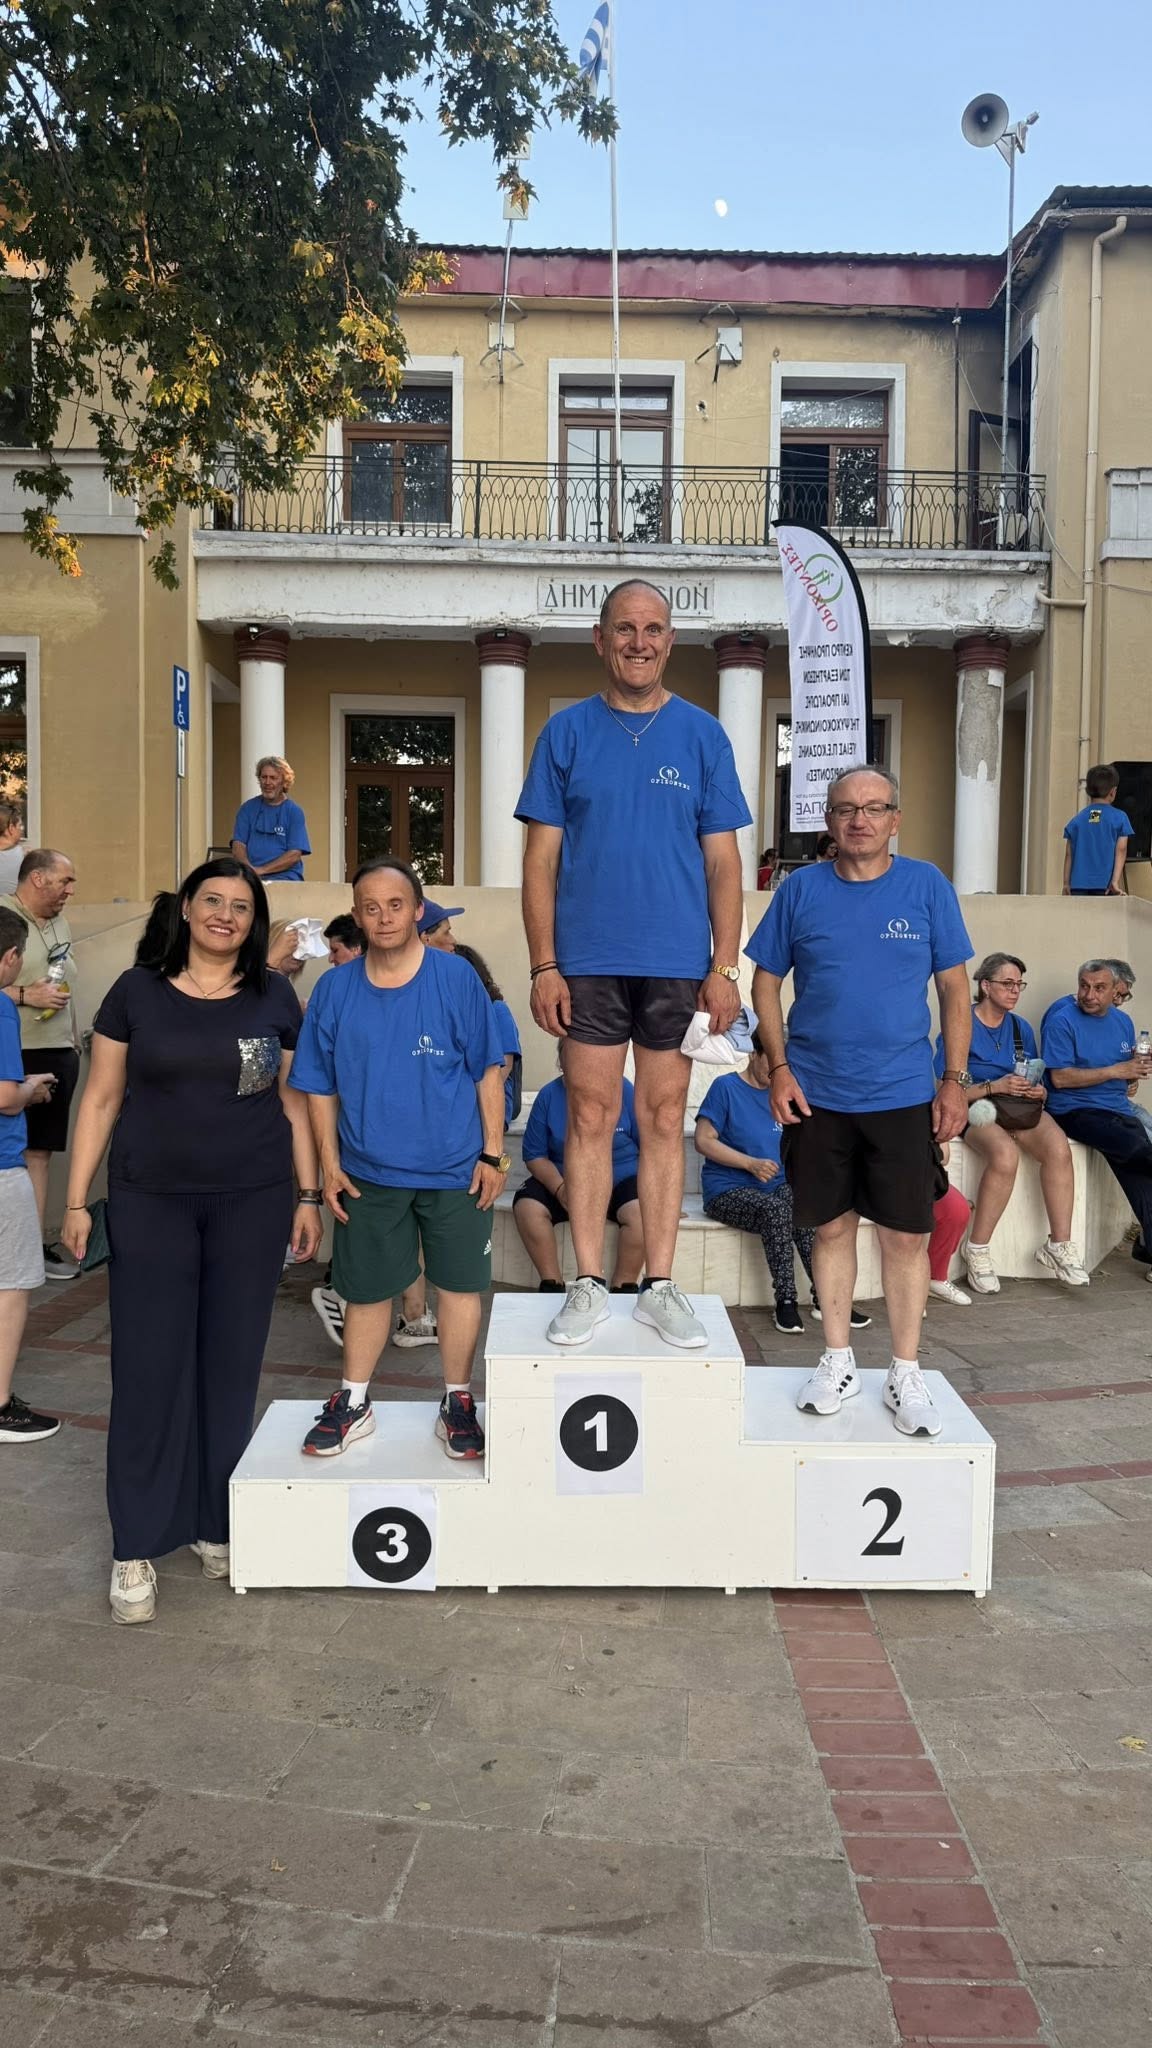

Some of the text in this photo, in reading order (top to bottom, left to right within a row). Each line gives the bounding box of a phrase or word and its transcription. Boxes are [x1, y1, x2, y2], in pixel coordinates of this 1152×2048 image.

[545, 584, 708, 610] ΔΗΜΑΙΟΝ
[176, 669, 187, 702] P
[584, 1411, 608, 1452] 1
[860, 1486, 905, 1556] 2
[375, 1523, 409, 1564] 3
